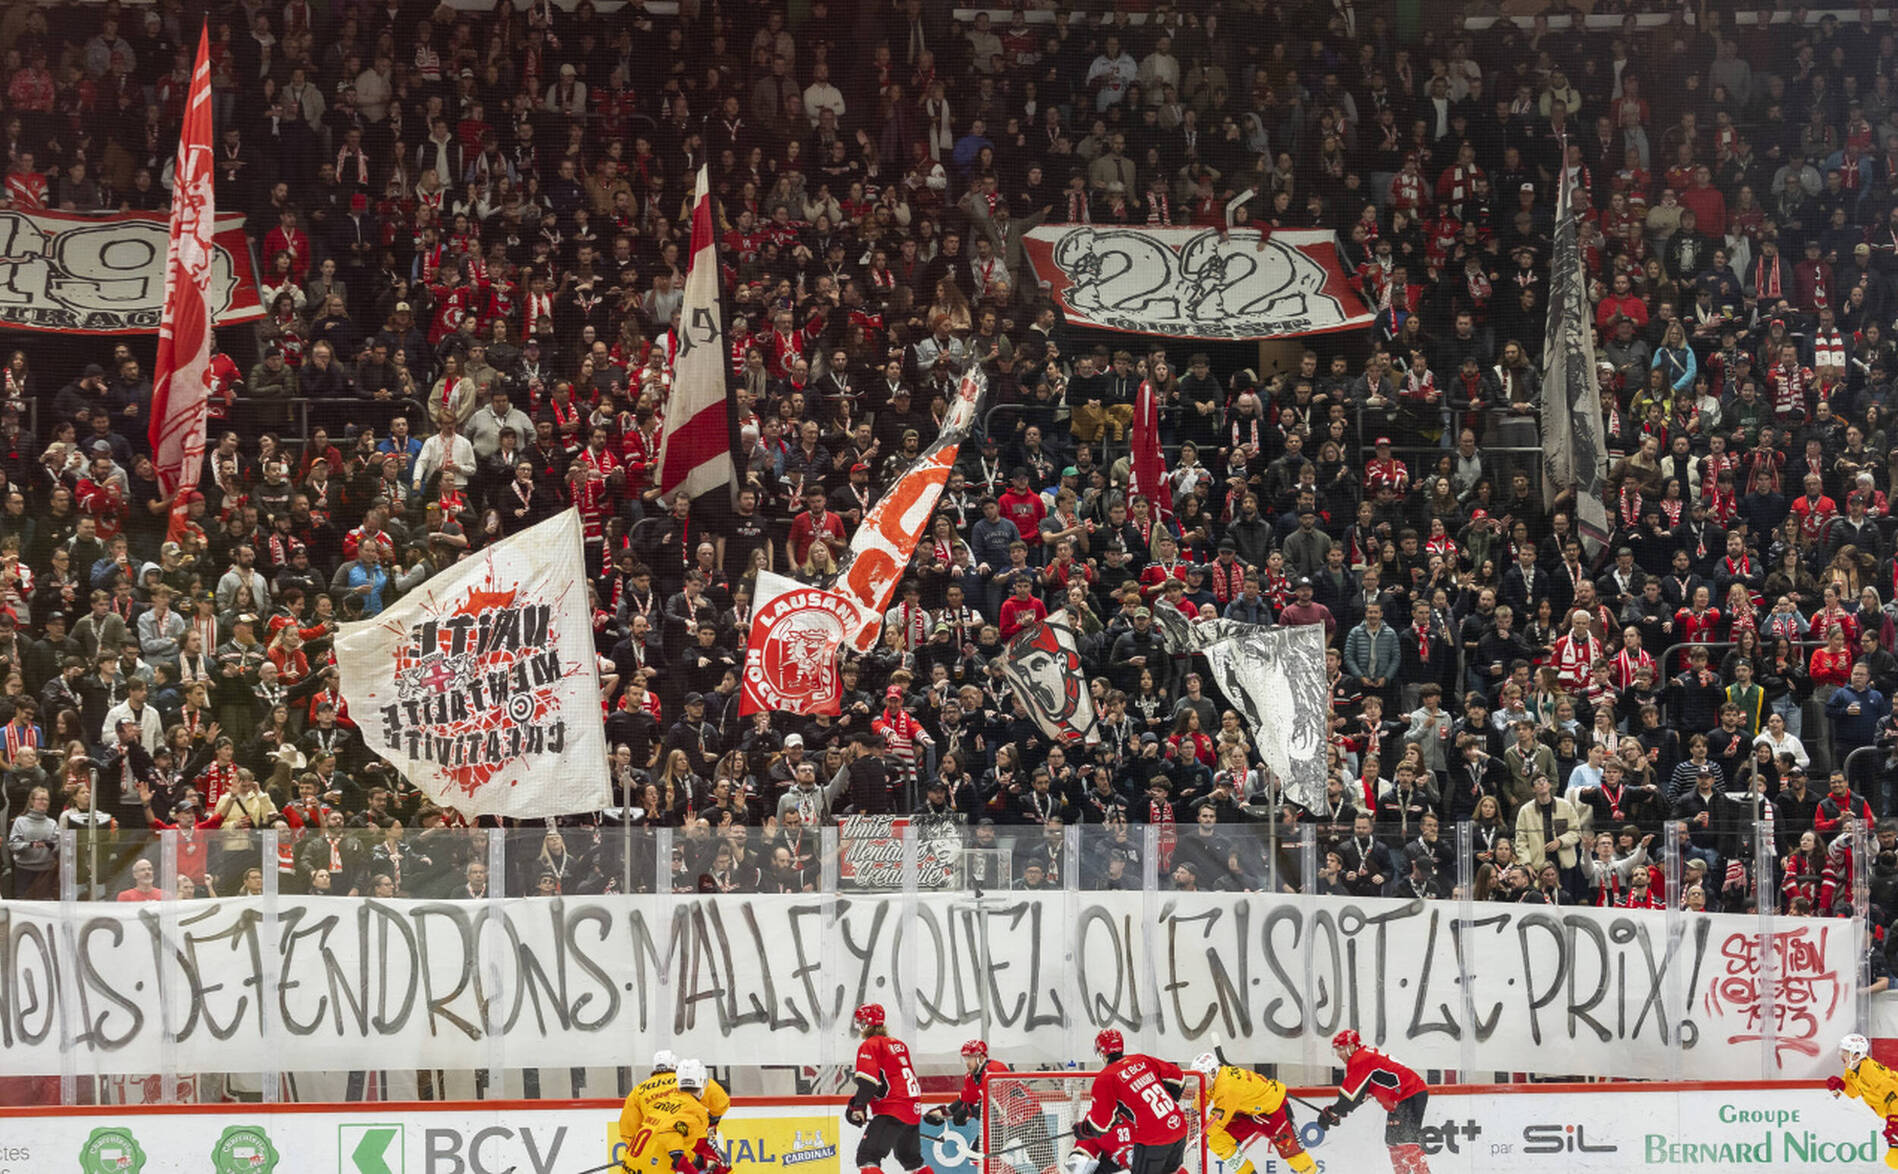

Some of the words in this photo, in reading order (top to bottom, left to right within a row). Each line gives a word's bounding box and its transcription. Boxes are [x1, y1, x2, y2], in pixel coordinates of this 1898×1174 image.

[760, 593, 860, 635] LAUSANN
[1407, 908, 1511, 1043] LE
[1141, 1083, 1175, 1119] 23
[425, 1126, 568, 1174] BCV
[1116, 1127, 1131, 1142] 33
[1420, 1119, 1482, 1155] et+
[785, 1147, 834, 1164] CARDINAL
